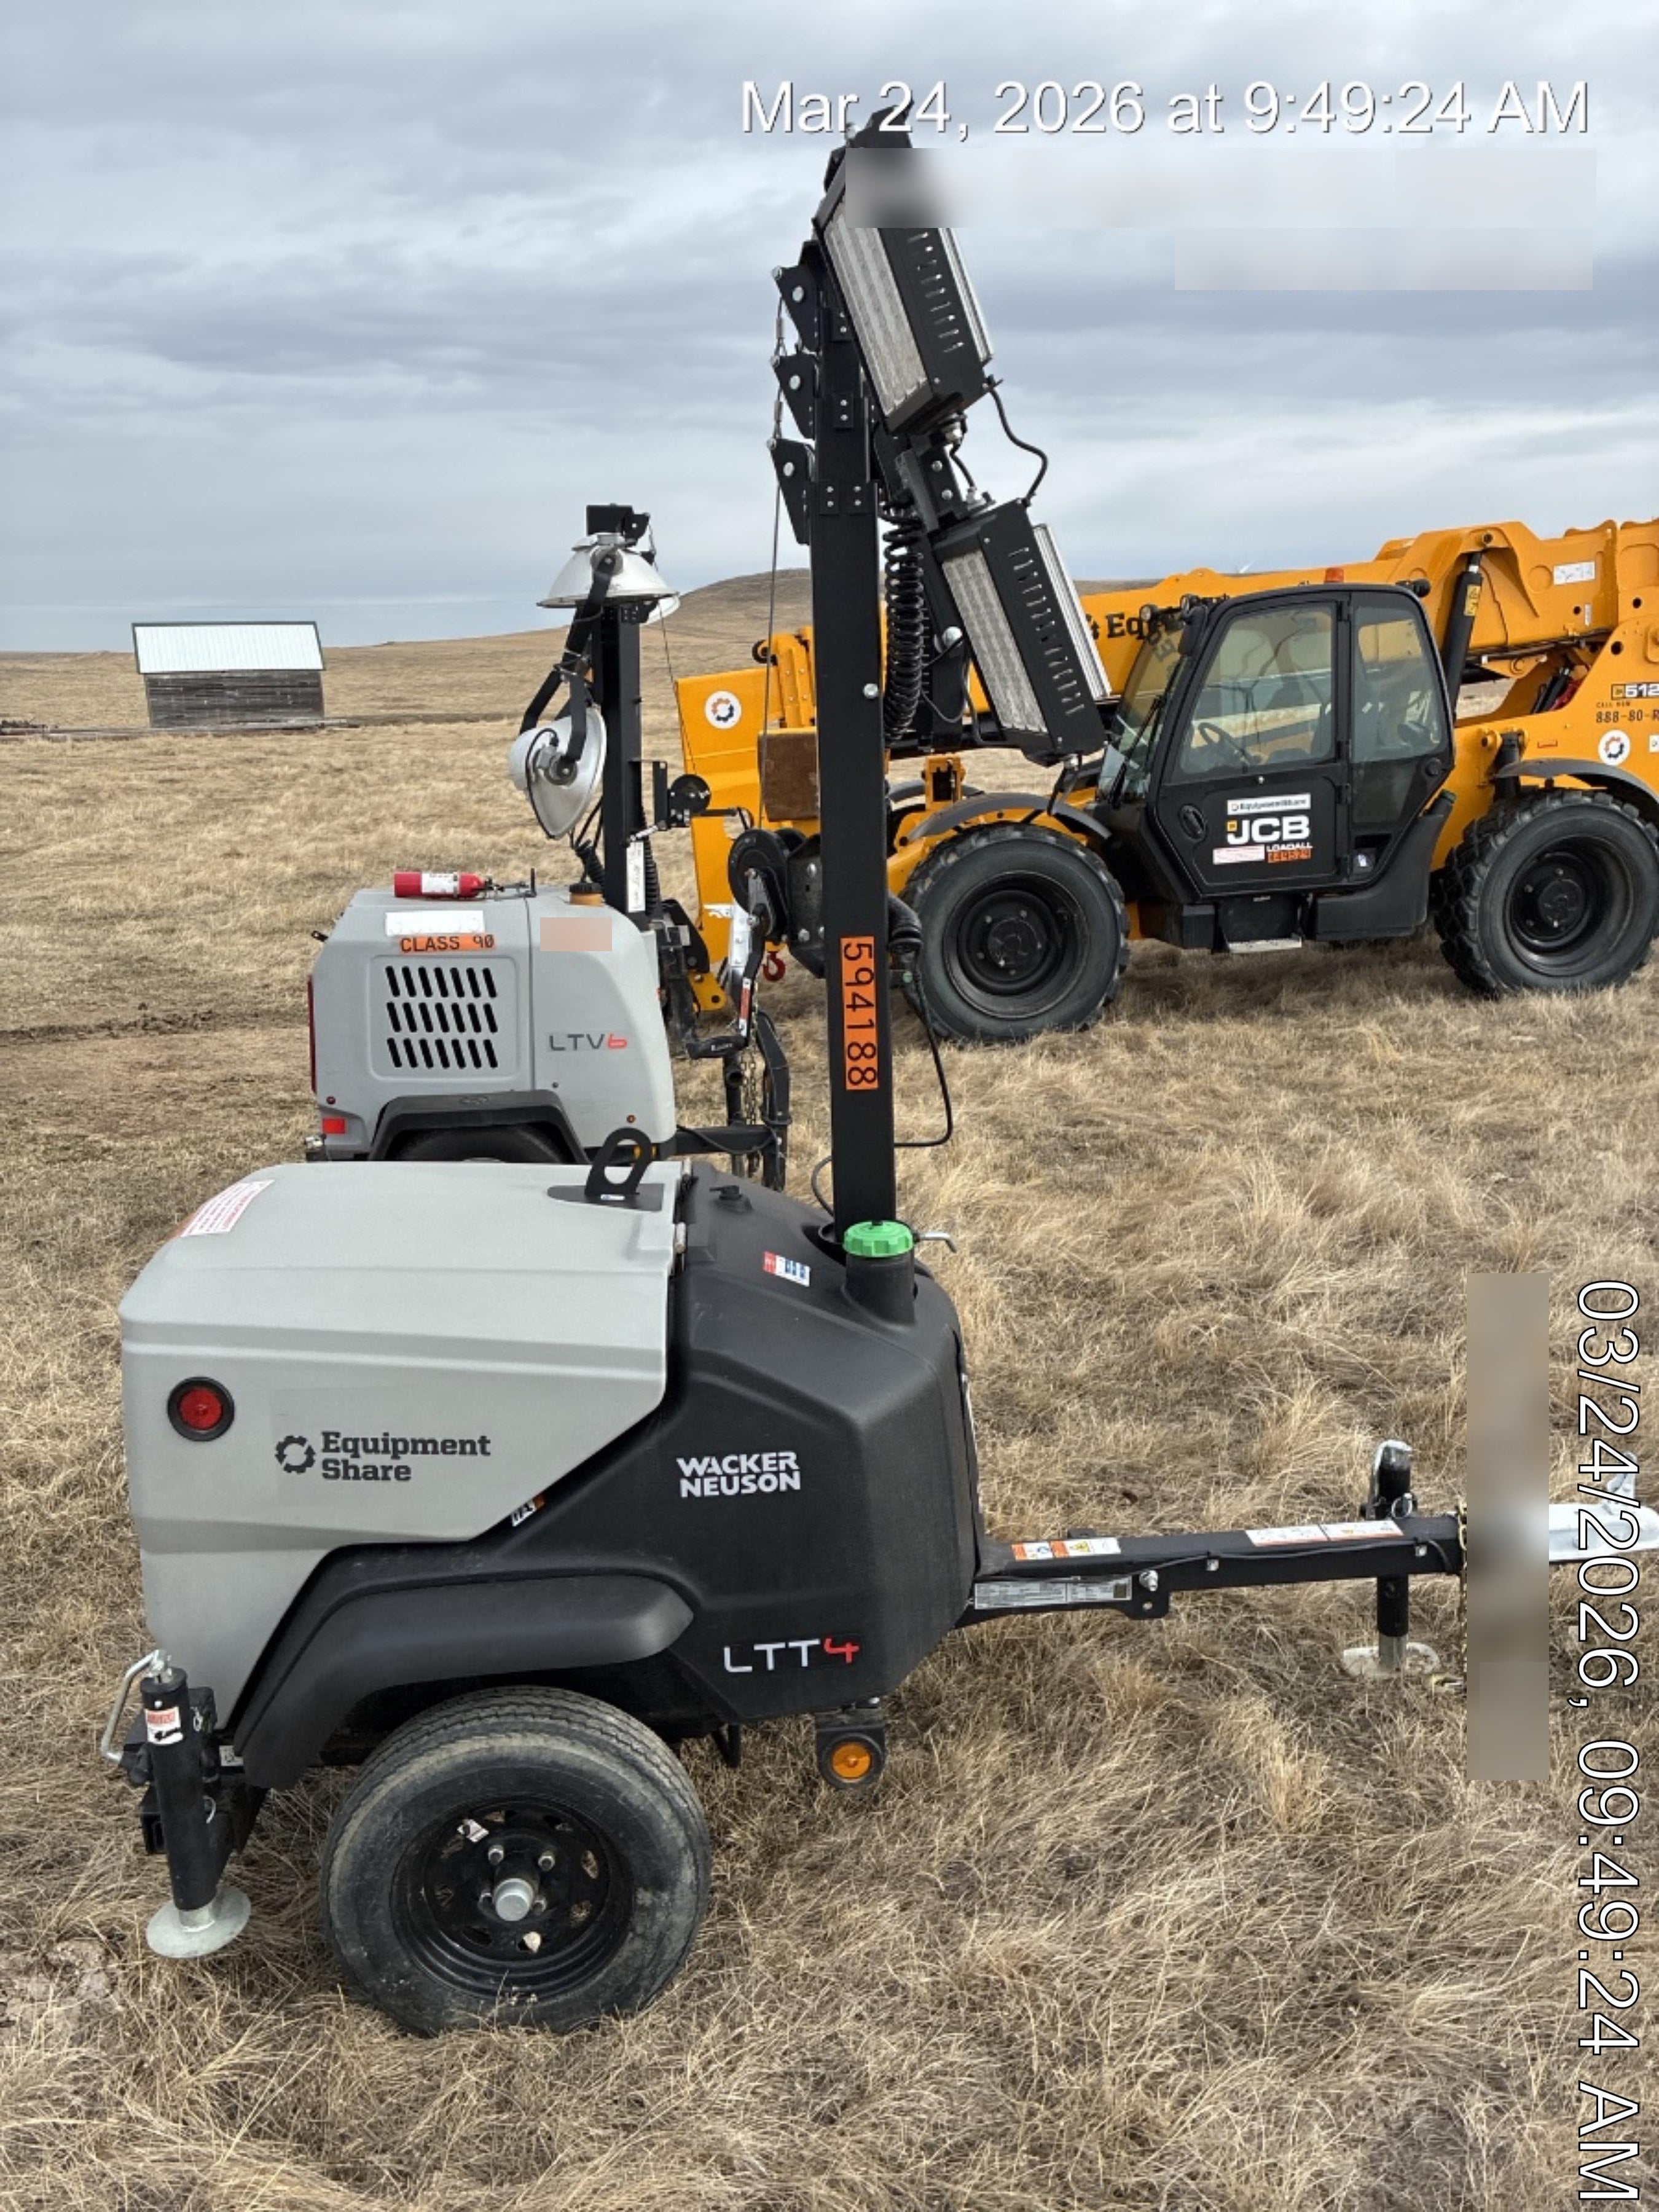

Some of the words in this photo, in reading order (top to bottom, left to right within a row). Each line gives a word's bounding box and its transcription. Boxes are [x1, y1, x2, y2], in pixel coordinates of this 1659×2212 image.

[1227, 814, 1311, 845] JCB
[400, 936, 460, 953] CLASS
[473, 934, 495, 949] 90
[844, 943, 877, 1085] 594188
[549, 1032, 627, 1051] LTV6
[321, 1430, 491, 1460] Equipment
[321, 1458, 412, 1481] Share
[676, 1450, 801, 1477] WACKER
[680, 1470, 801, 1498] NEUSON
[723, 1637, 860, 1673] LTT4
